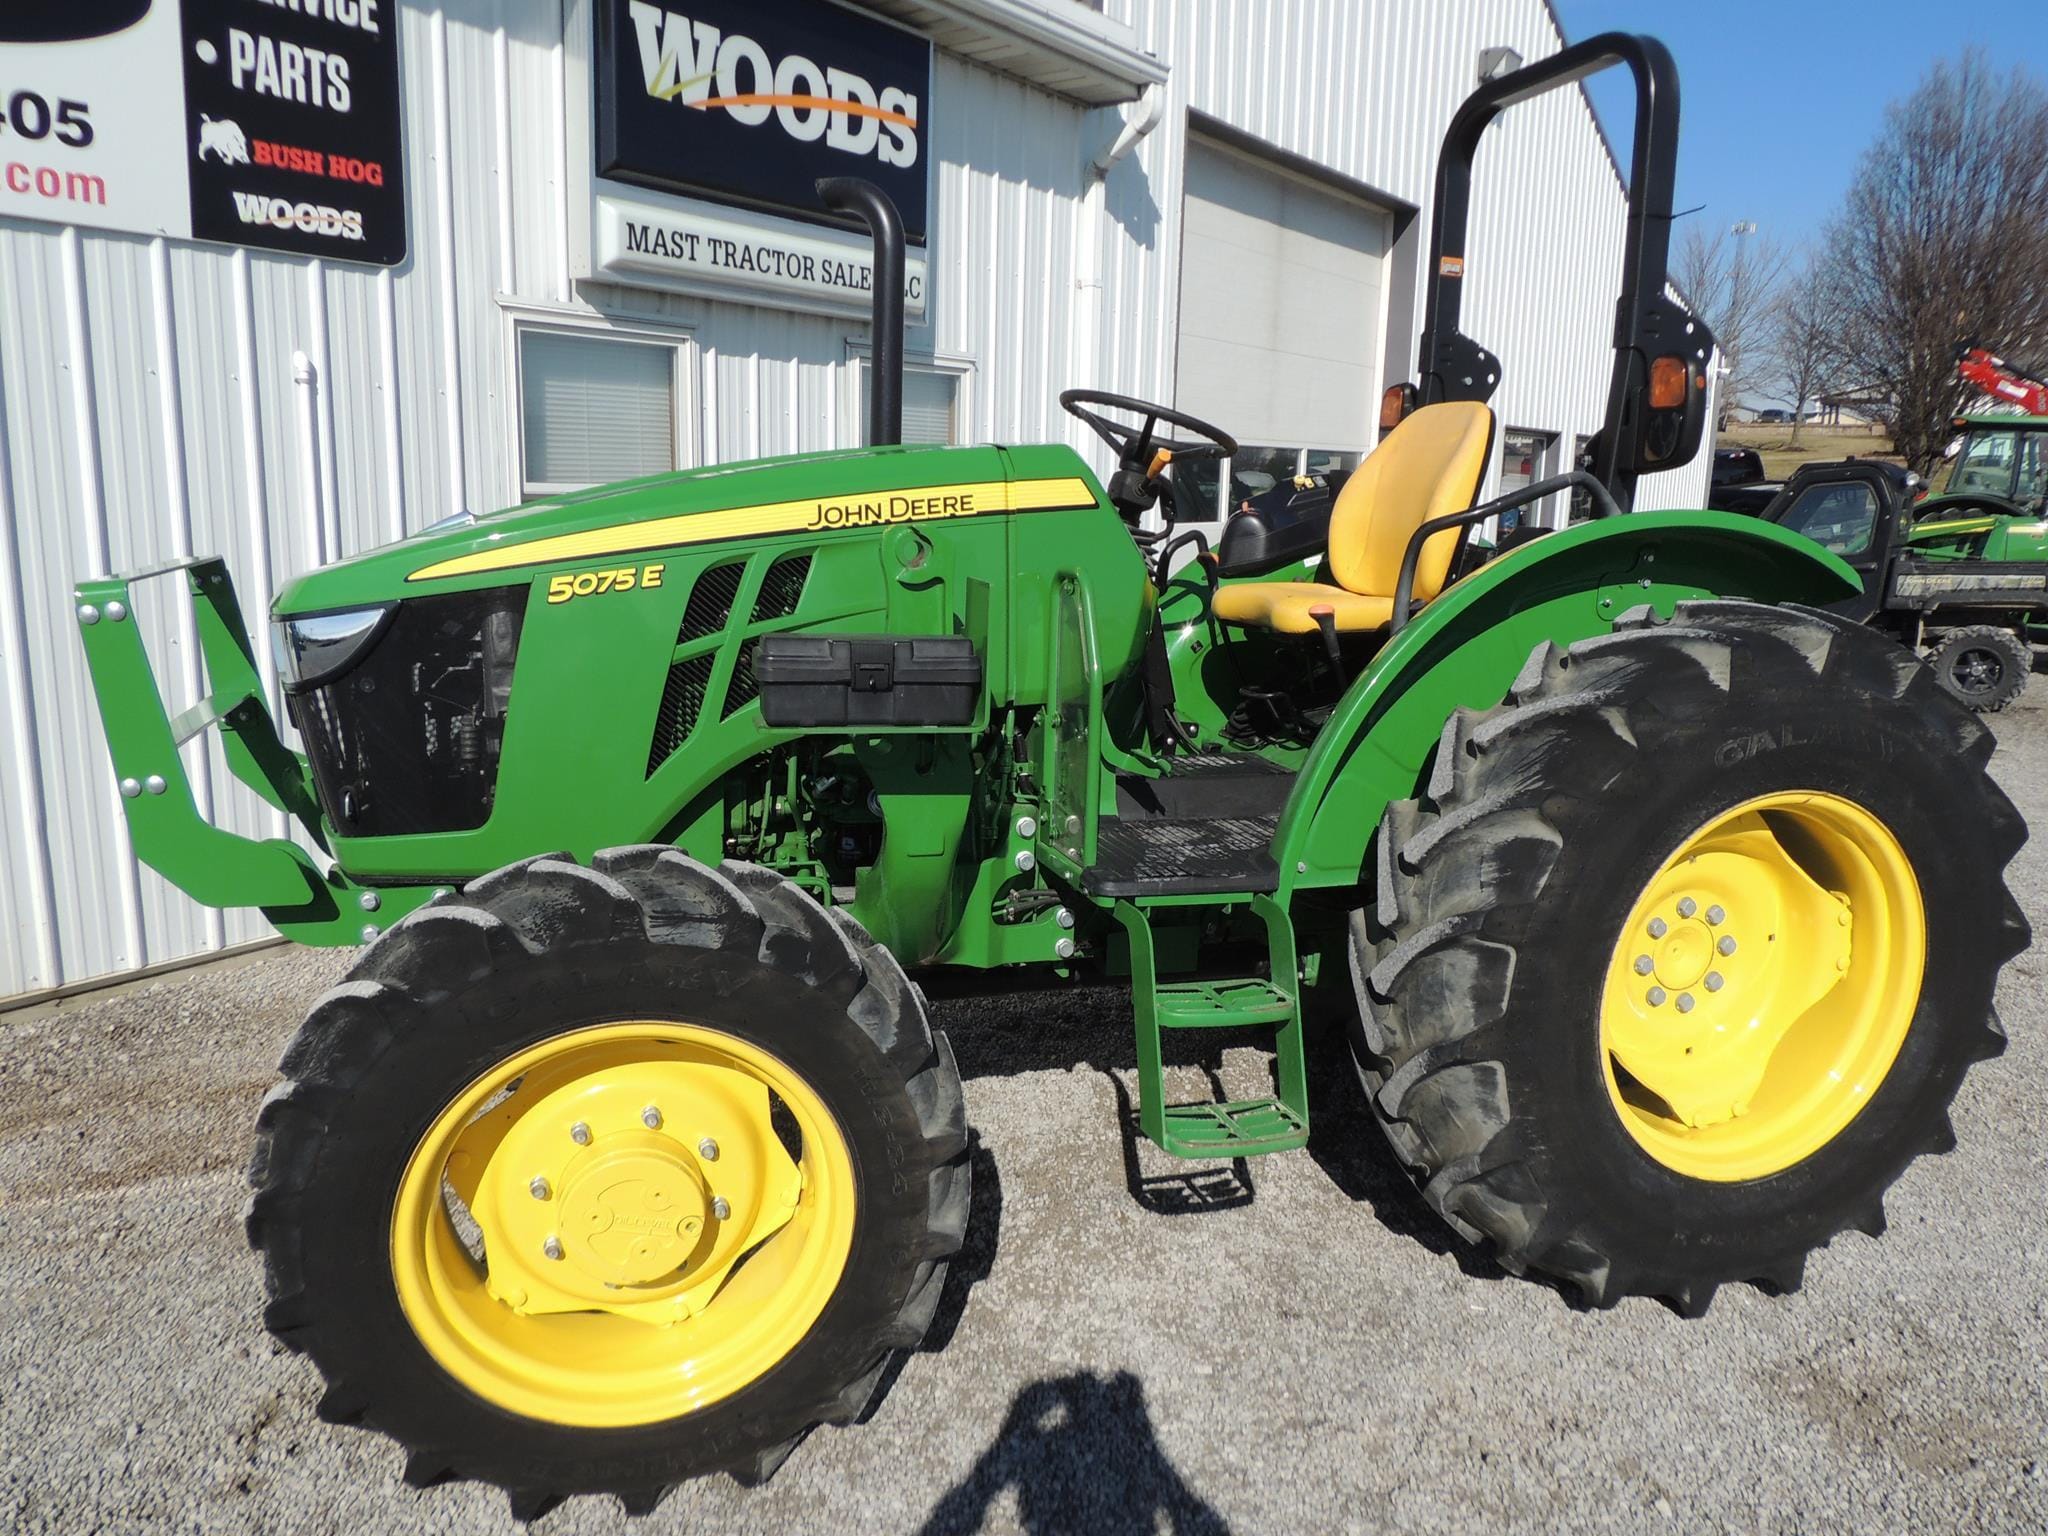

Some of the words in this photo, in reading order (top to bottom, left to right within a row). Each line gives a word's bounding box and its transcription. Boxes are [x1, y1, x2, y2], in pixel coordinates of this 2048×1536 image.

[229, 27, 351, 114] PARTS
[629, 0, 917, 168] WOODS
[0, 91, 94, 148] 05
[0, 161, 106, 205] com
[252, 139, 325, 176] BUSH
[328, 153, 383, 187] HOG
[233, 191, 364, 241] WOODS
[626, 221, 700, 261] MAST
[707, 237, 816, 281] TRACTOR
[821, 258, 872, 291] SALE
[807, 503, 883, 528] JOHN
[889, 494, 974, 519] DEERE
[547, 566, 638, 604] 5075
[640, 563, 665, 588] E
